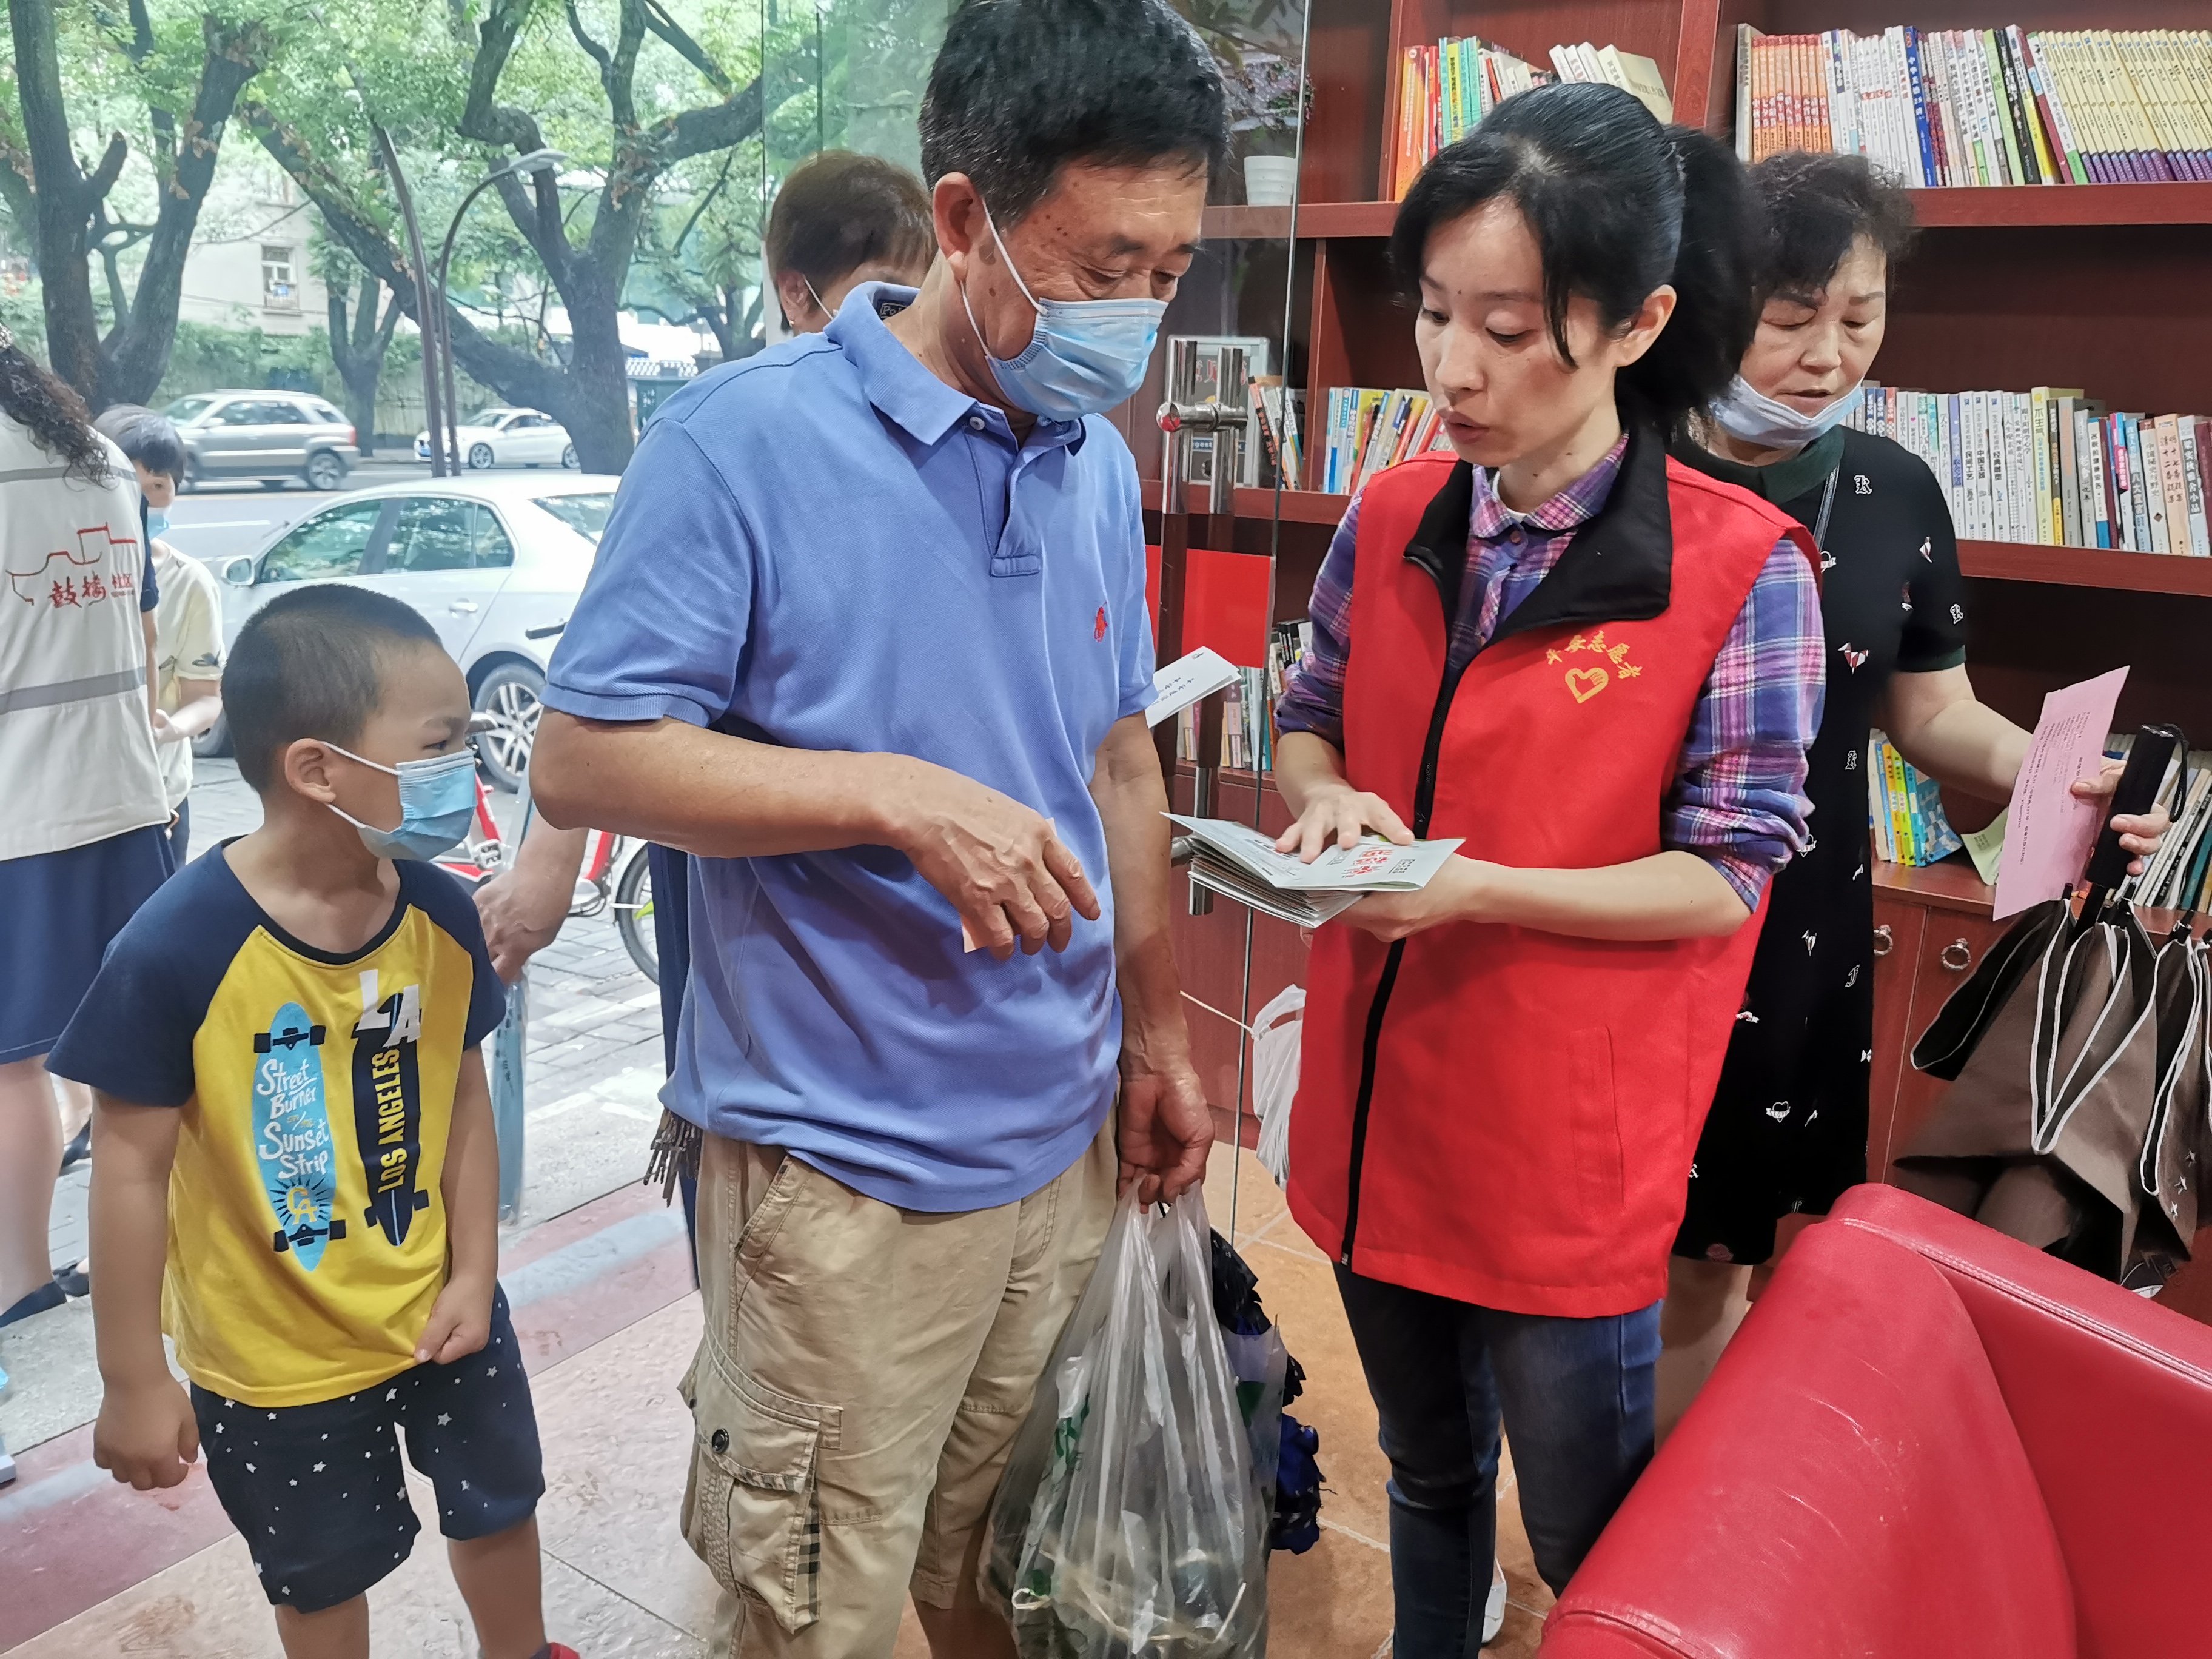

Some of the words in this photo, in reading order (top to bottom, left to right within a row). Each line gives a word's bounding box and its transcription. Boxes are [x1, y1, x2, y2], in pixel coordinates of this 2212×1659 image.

[355, 969, 422, 1047] LA
[256, 1058, 310, 1096] Street
[371, 1048, 405, 1145] ANGELES
[270, 1086, 317, 1119] Burner
[258, 1118, 329, 1159] Sunset
[278, 1150, 328, 1179] Strip
[377, 1148, 407, 1193] LOS
[286, 1187, 317, 1225] CA
